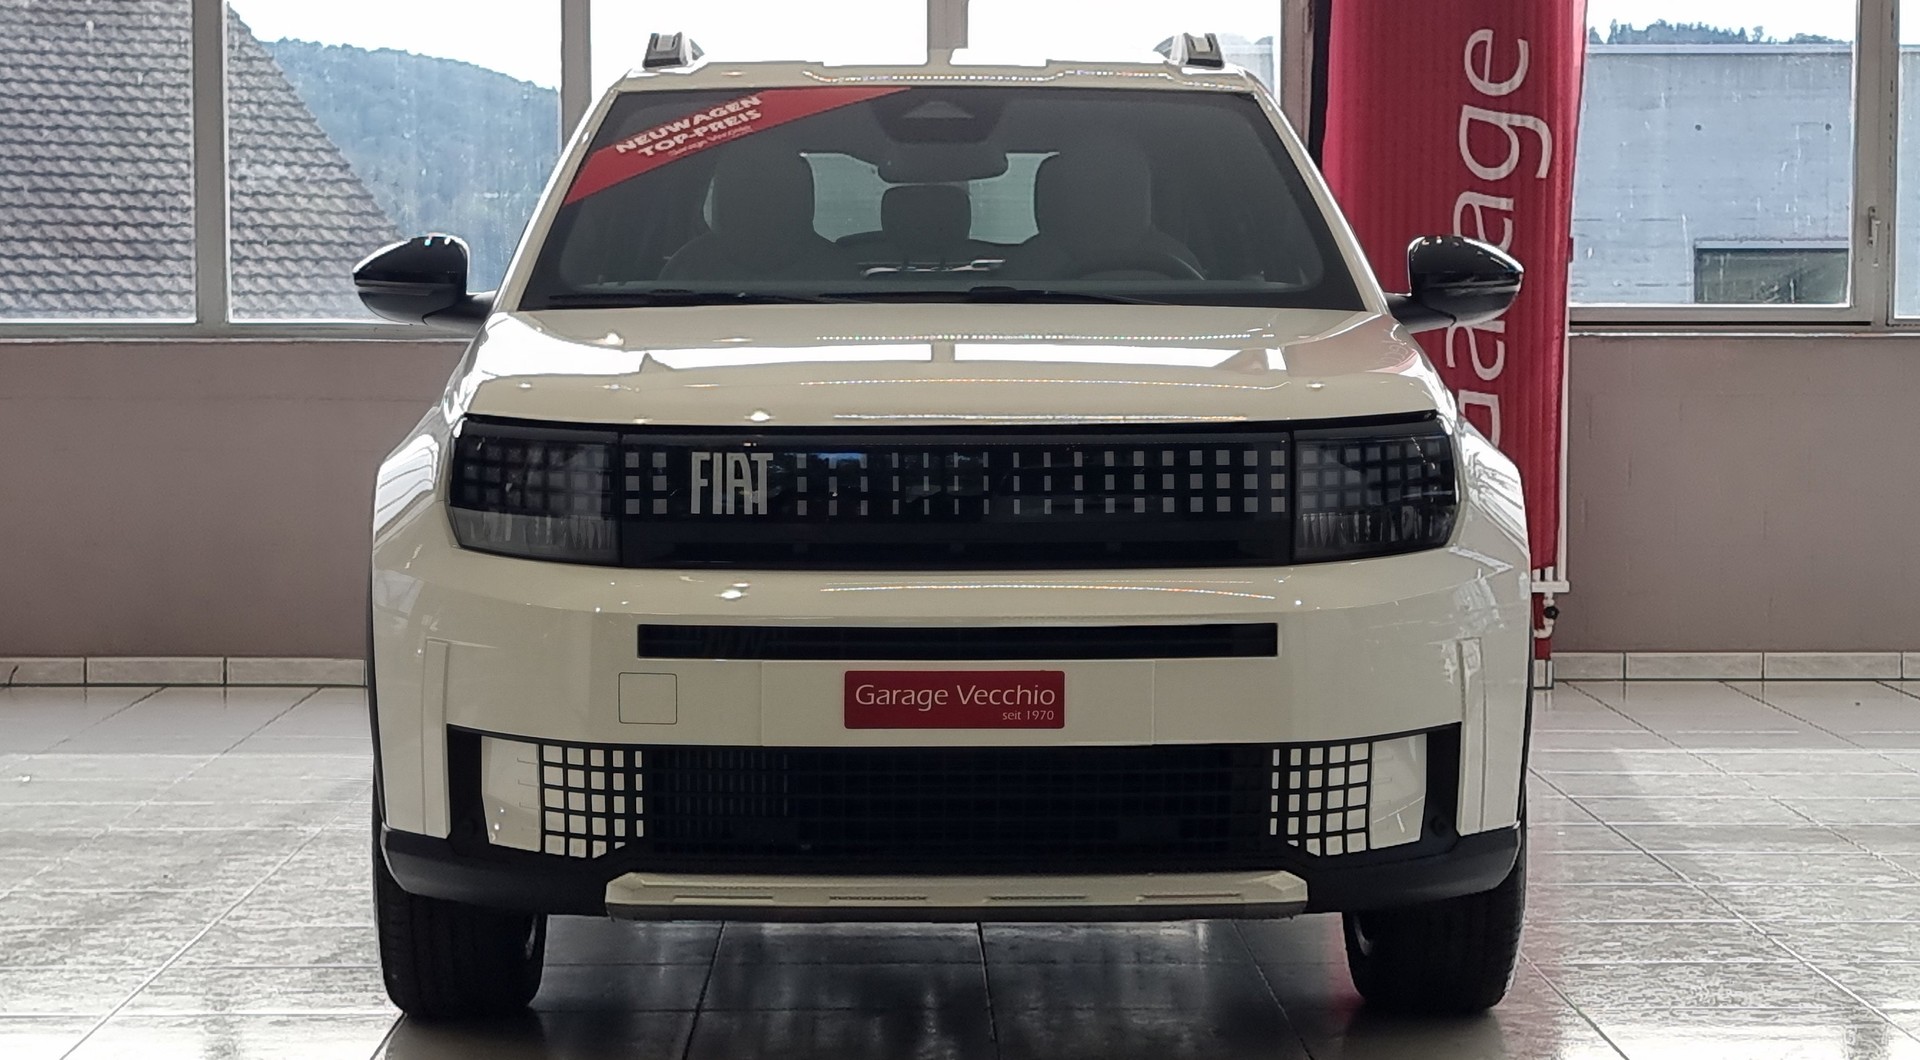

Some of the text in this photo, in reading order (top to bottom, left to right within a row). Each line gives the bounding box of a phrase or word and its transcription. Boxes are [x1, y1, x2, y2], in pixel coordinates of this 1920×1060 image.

[616, 96, 762, 154] NEUWAGEN
[638, 109, 762, 157] TOP-PREIS
[1446, 28, 1553, 448] aage
[690, 451, 774, 515] FIAT
[855, 684, 1056, 712] Garage Vecchio
[1002, 710, 1055, 721] seit 1970
